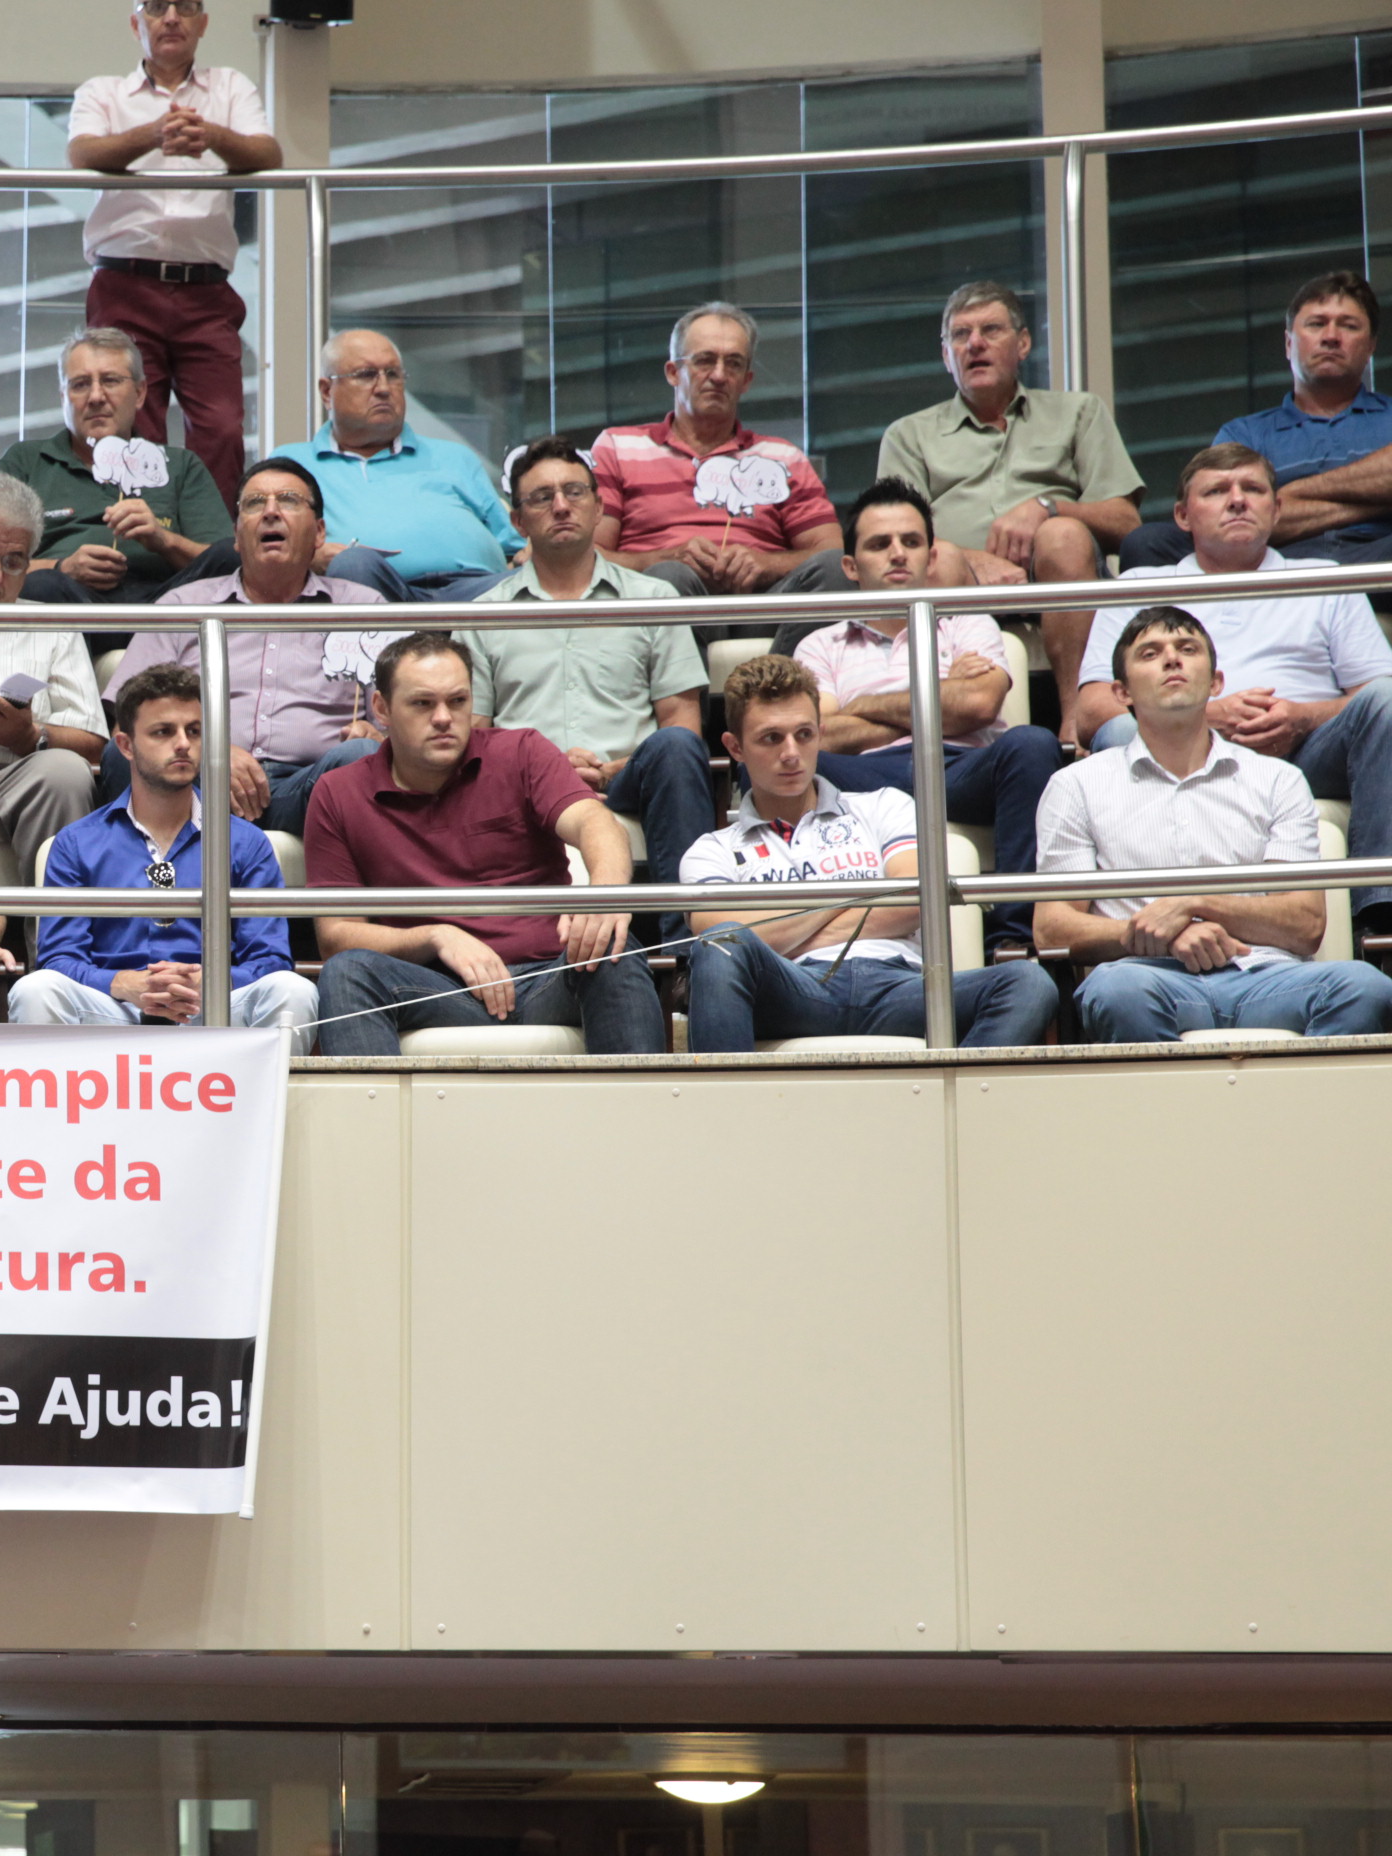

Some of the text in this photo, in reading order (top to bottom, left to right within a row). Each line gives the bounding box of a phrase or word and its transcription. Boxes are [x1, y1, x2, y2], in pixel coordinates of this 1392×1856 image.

[819, 851, 879, 874] CLUB
[74, 1144, 162, 1202] da
[38, 1374, 244, 1440] Ajuda!
